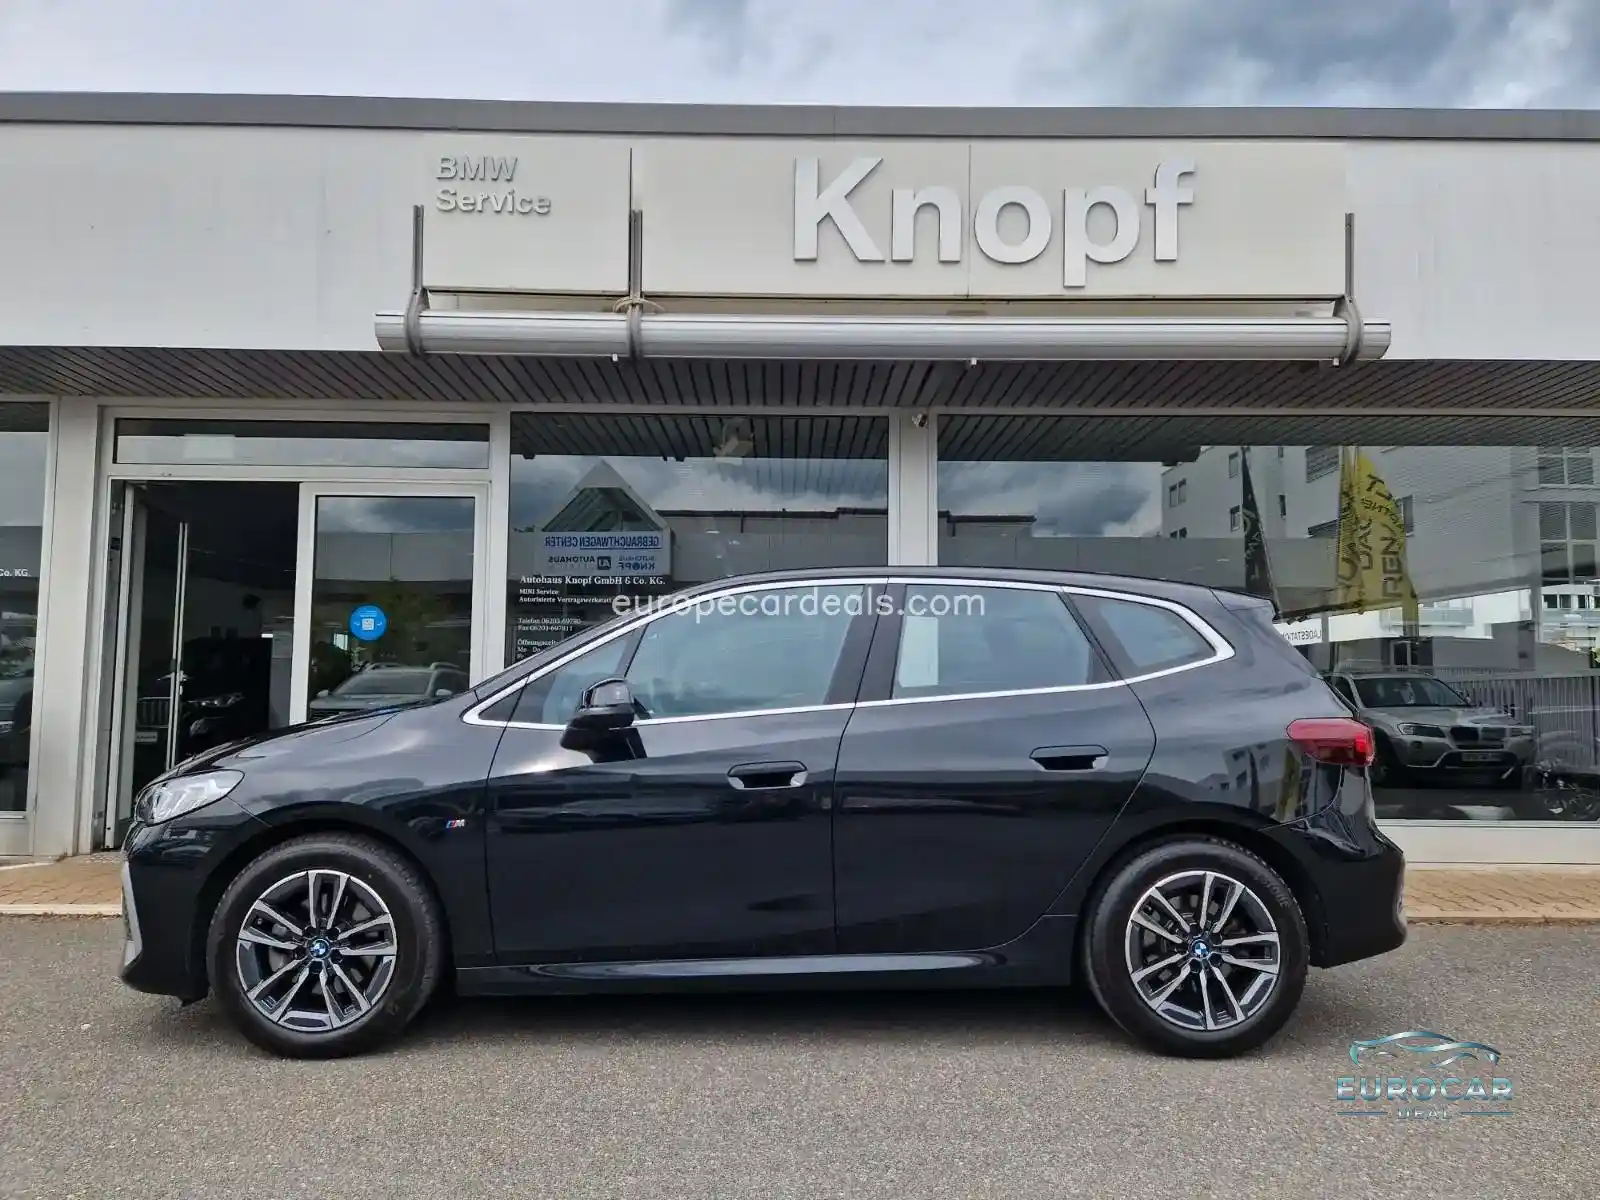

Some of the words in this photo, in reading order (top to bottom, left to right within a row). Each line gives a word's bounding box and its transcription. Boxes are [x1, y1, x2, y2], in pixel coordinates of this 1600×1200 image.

[436, 155, 518, 181] BMW
[436, 188, 551, 215] Service
[792, 154, 1196, 288] Knopf
[14, 568, 31, 577] KG.
[520, 575, 562, 584] Autohaus
[565, 575, 592, 586] Knopf
[594, 576, 622, 585] GmbH
[633, 576, 647, 585] Co.
[649, 576, 666, 585] KG.
